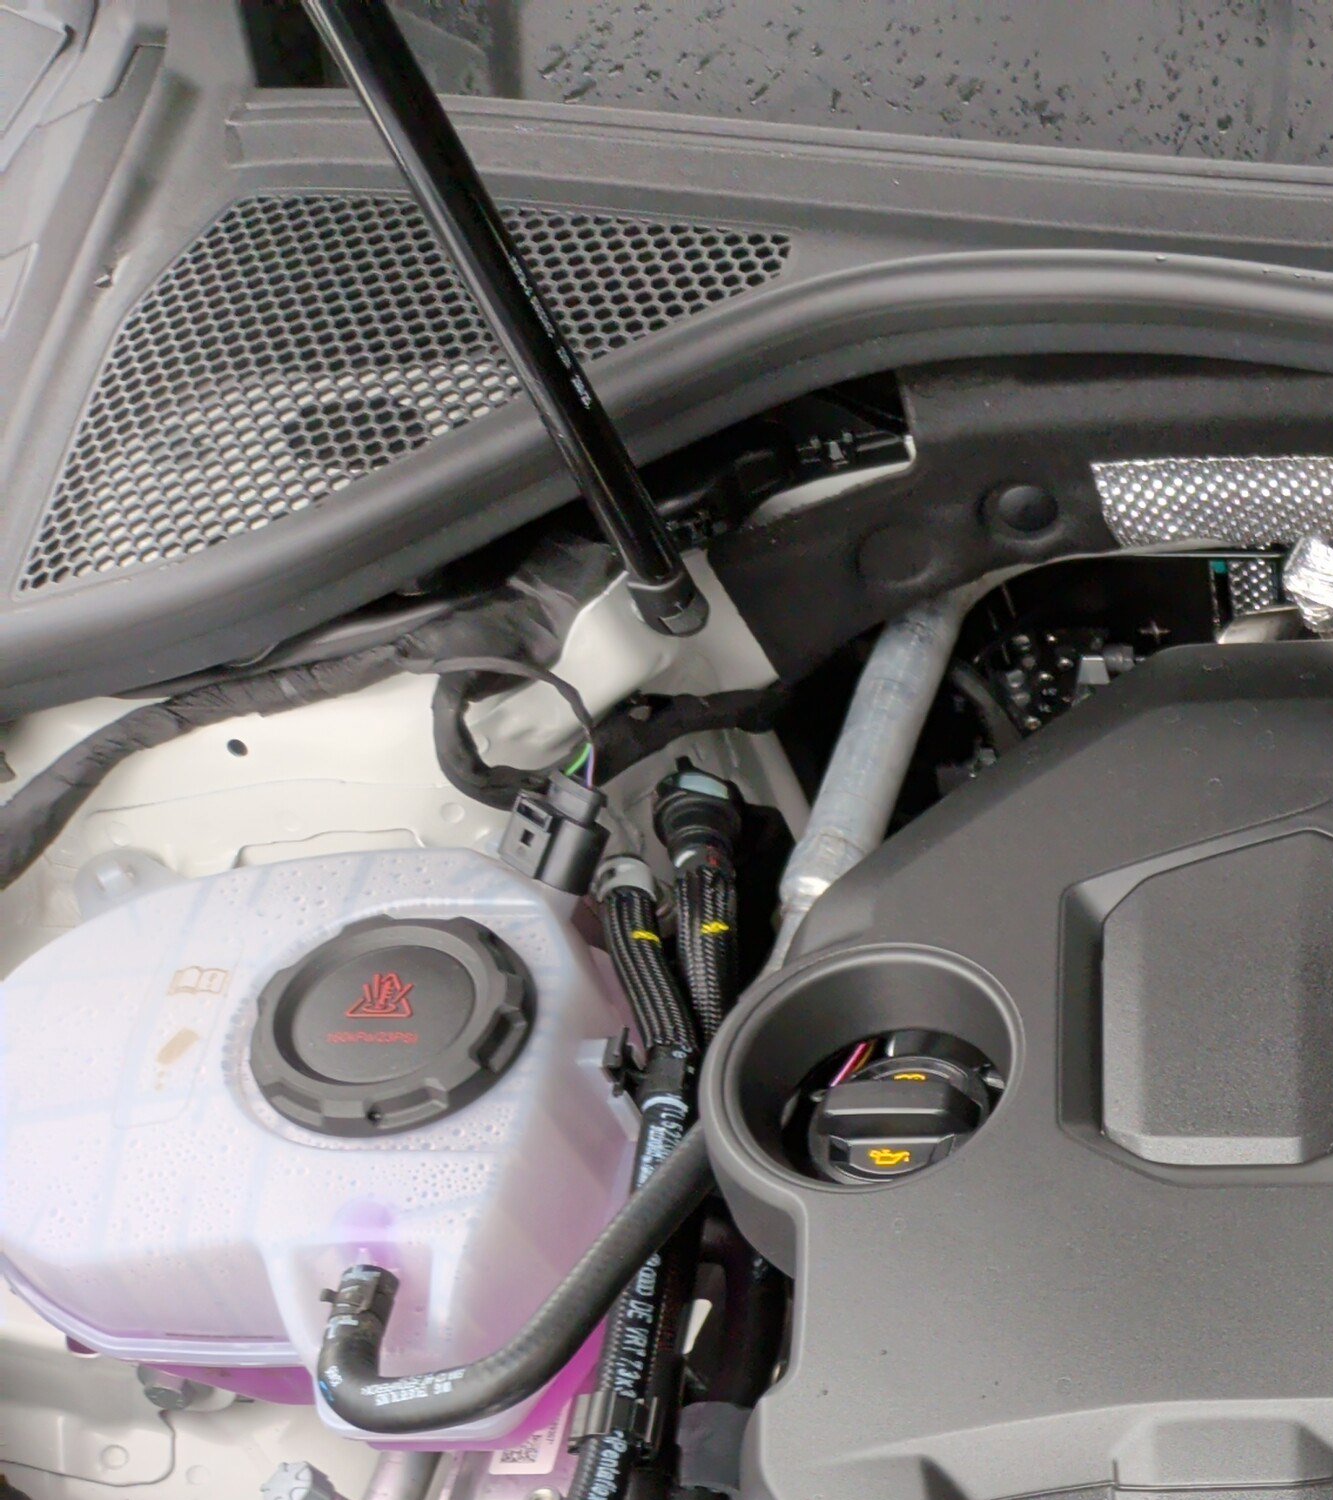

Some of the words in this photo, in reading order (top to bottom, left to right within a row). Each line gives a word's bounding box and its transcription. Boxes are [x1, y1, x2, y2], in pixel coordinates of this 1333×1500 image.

[628, 1300, 652, 1324] DE
[622, 1326, 650, 1355] VRT
[613, 1358, 644, 1399] 7,3x3
